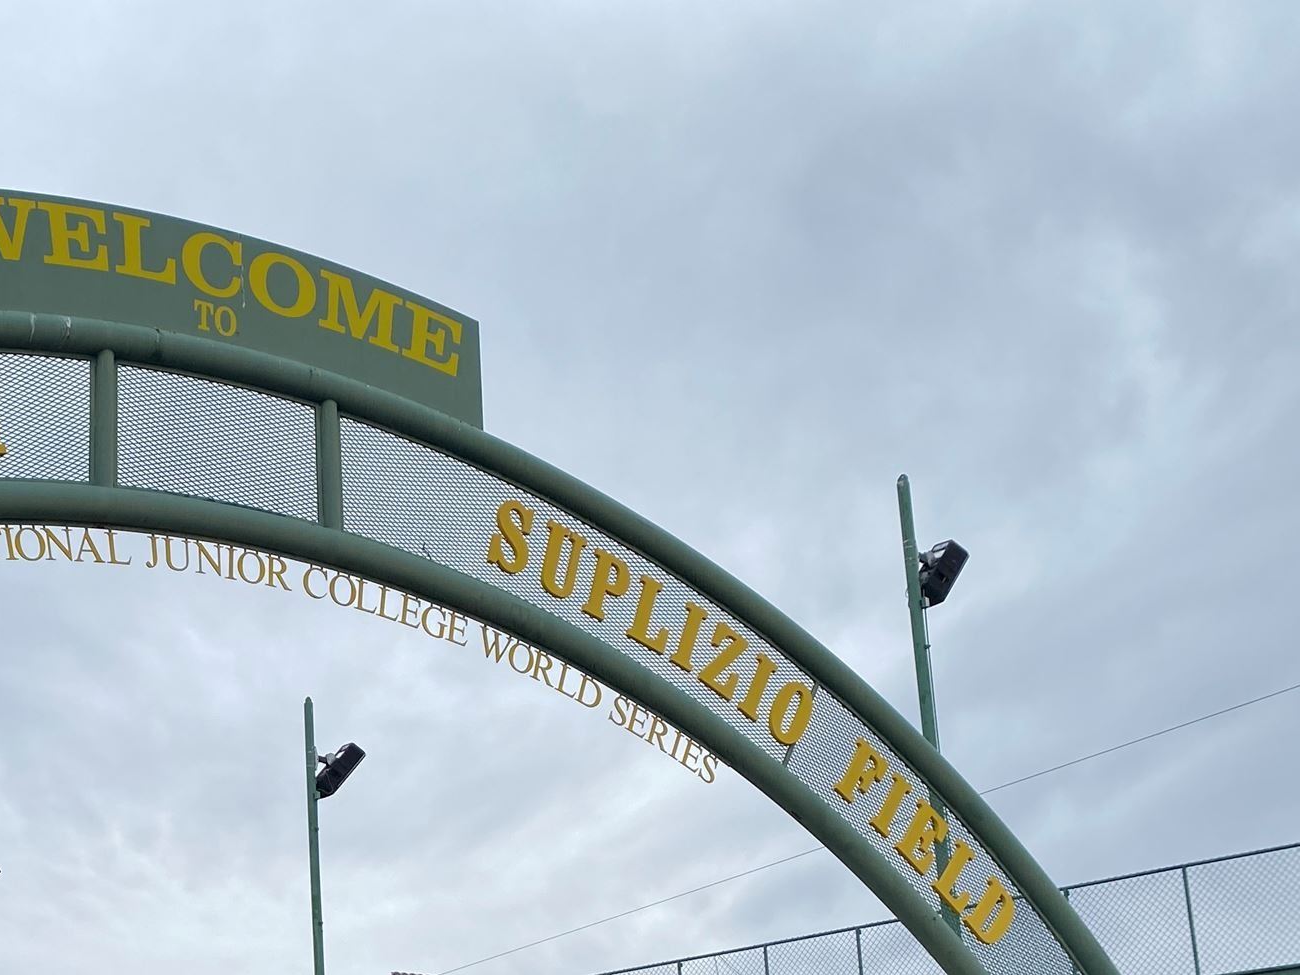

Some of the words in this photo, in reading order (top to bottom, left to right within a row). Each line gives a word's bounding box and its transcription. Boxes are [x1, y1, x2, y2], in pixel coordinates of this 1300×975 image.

[194, 300, 238, 337] TO
[146, 533, 293, 593] JUNIOR
[301, 563, 469, 648] COLLEGE
[479, 623, 602, 709] WORLD
[609, 695, 720, 785] SERIES
[487, 499, 814, 746] SUPLIZIO
[833, 737, 1017, 946] FIELD
